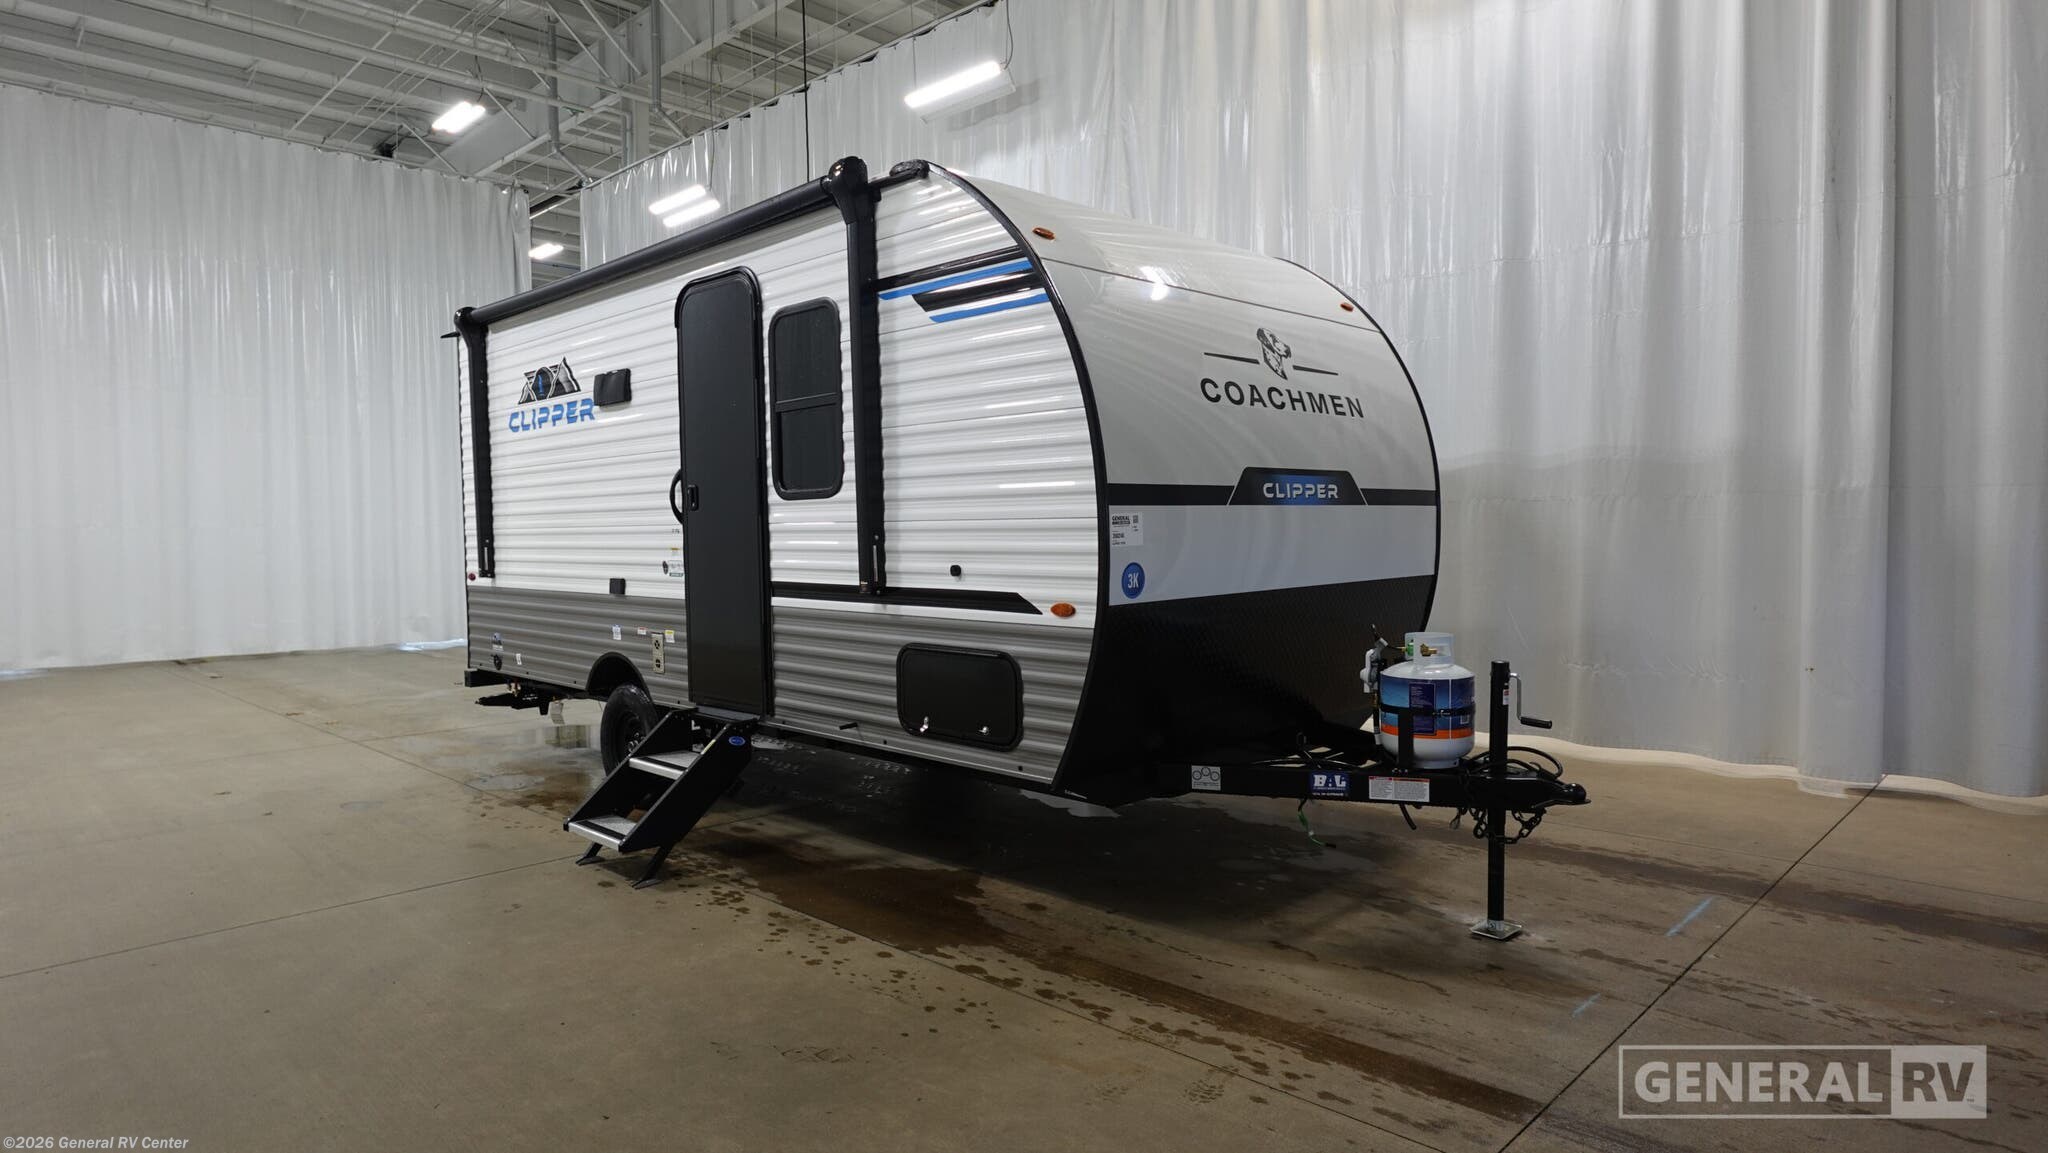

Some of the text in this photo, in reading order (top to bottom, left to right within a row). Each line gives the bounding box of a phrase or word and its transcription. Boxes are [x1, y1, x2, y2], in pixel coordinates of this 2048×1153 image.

[1200, 377, 1364, 418] COACHMEN
[508, 397, 596, 433] CLIPPER
[1263, 482, 1339, 499] CLIPPER
[1127, 572, 1140, 589] 3K
